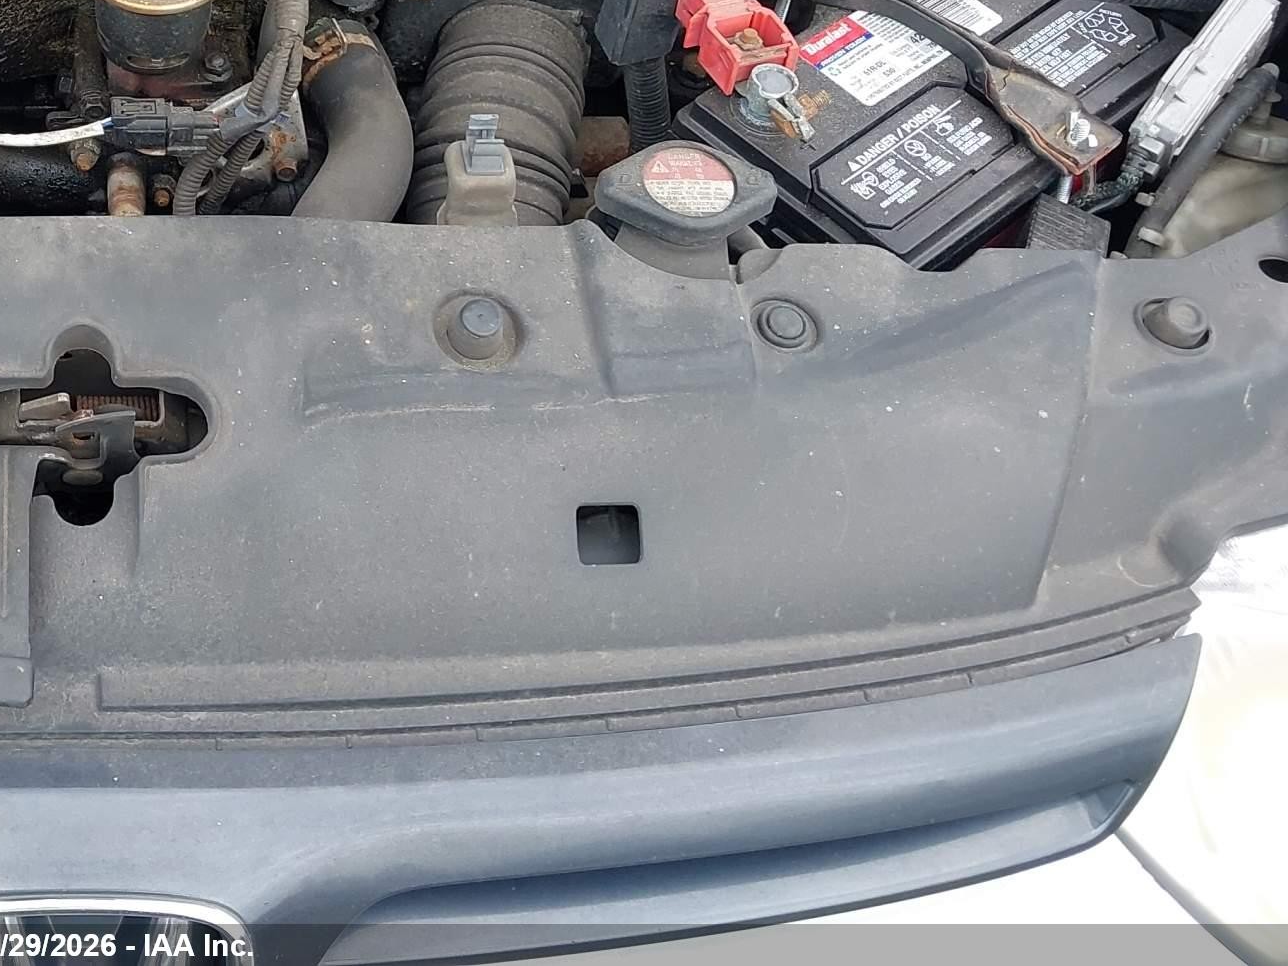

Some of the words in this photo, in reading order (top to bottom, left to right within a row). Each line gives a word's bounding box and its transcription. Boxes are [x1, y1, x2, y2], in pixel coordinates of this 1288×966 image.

[800, 22, 852, 55] Duralast
[856, 133, 899, 165] DANGER
[905, 104, 941, 133] POISON
